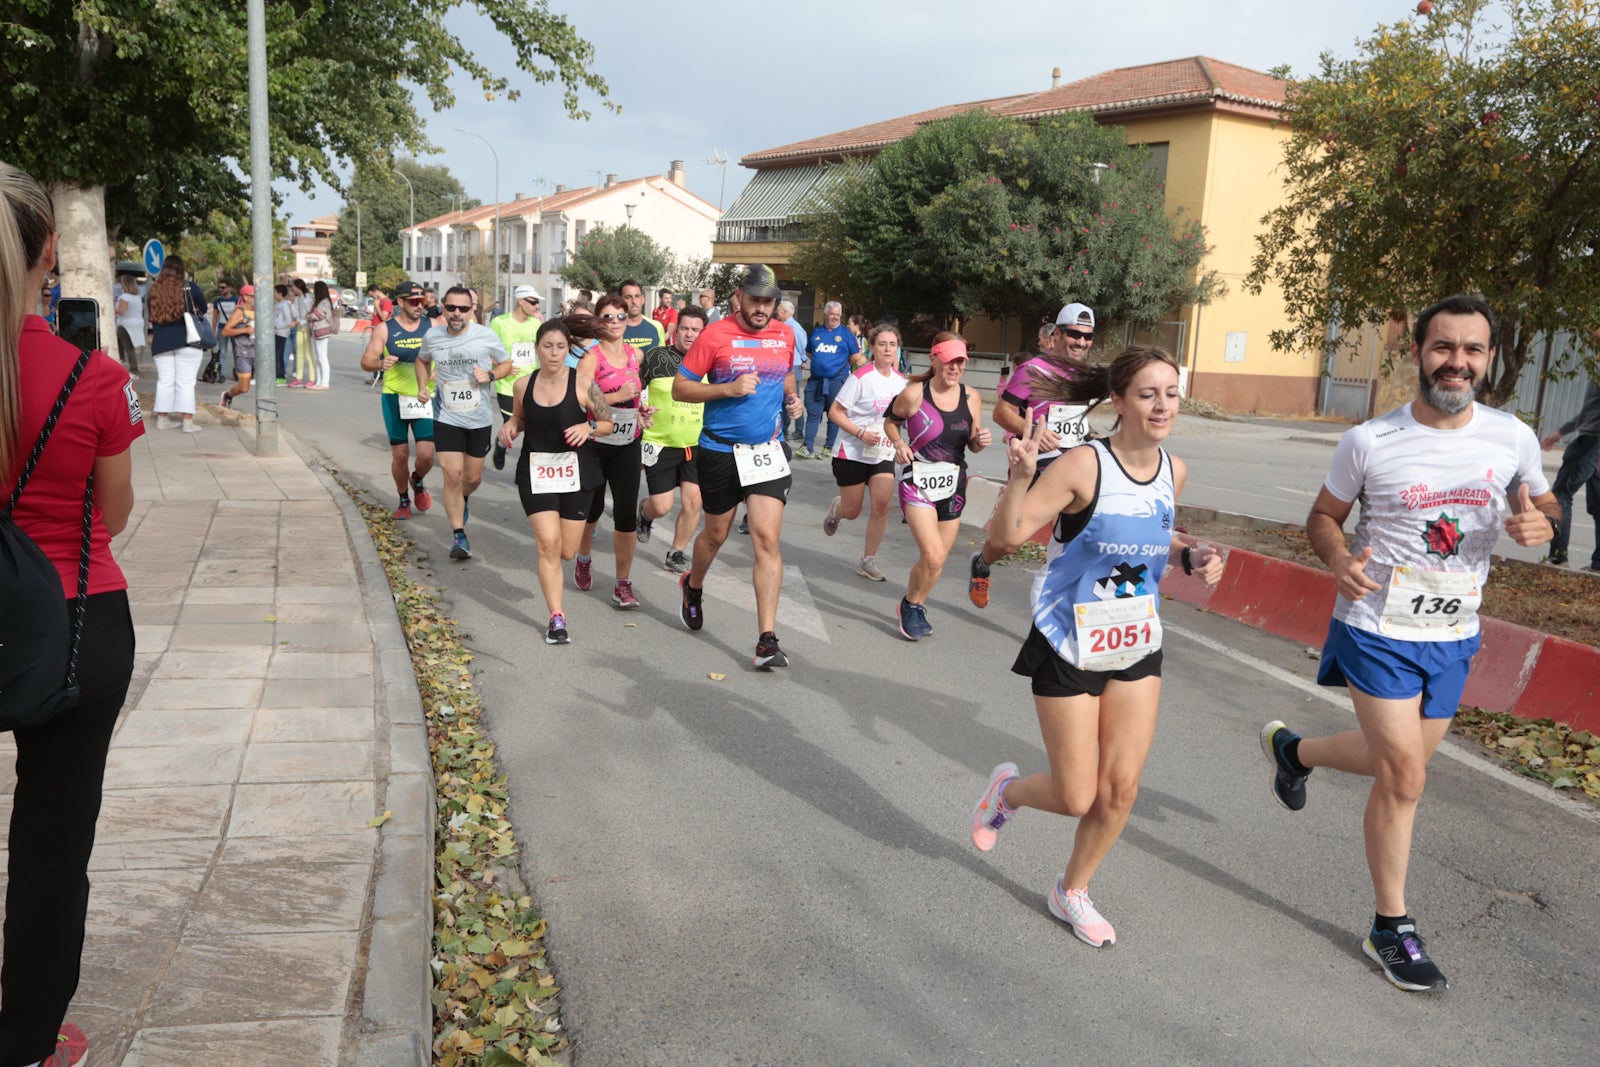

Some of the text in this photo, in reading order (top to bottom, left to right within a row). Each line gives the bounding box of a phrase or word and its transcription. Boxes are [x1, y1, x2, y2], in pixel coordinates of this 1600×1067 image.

[516, 350, 530, 358] 641
[815, 342, 838, 354] AON
[438, 358, 478, 367] MARATHON
[450, 390, 472, 401] 748
[1053, 421, 1085, 435] 3030
[753, 453, 772, 467] 65
[536, 465, 574, 479] 2015
[919, 475, 954, 490] 3028
[1419, 490, 1447, 502] MEDIA
[1097, 541, 1139, 556] TODO
[1411, 594, 1462, 615] 136
[1089, 621, 1152, 654] 2051
